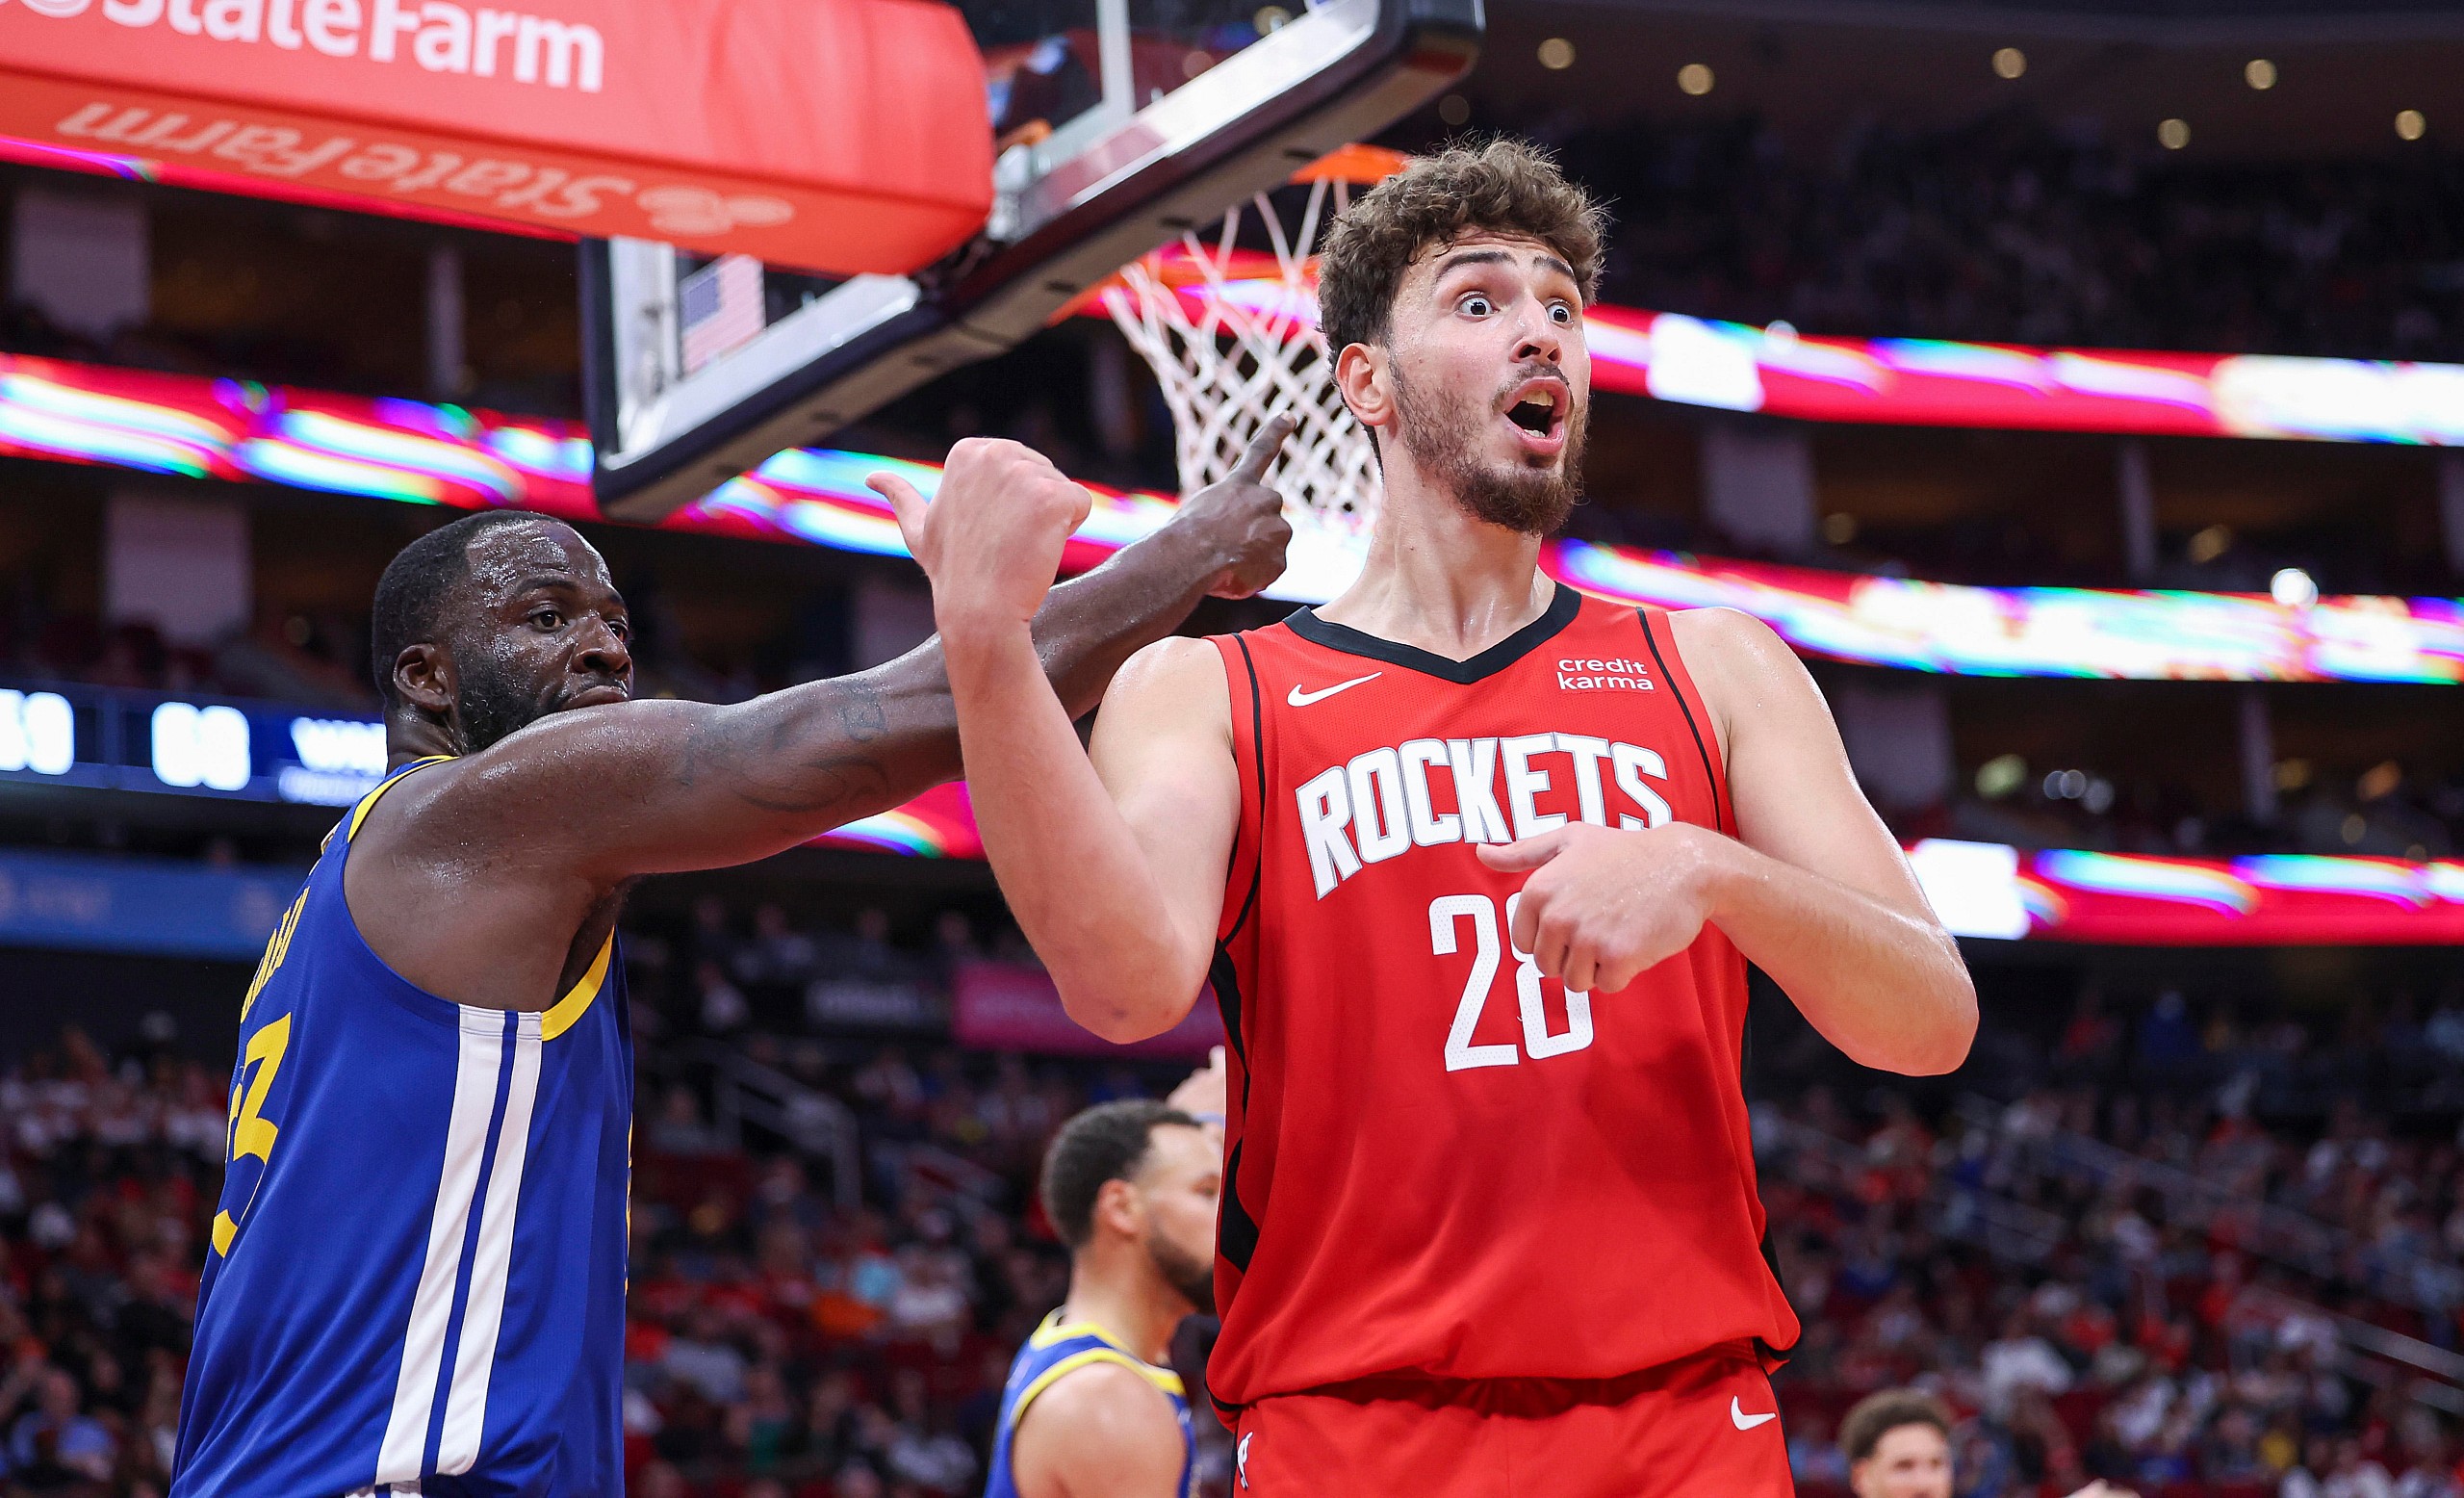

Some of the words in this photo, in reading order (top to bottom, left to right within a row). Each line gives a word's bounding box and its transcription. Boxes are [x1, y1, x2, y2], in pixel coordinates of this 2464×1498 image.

[1556, 671, 1655, 690] karma
[1558, 658, 1648, 675] credit
[1295, 732, 1673, 901] ROCKETS
[1428, 891, 1595, 1072] 28
